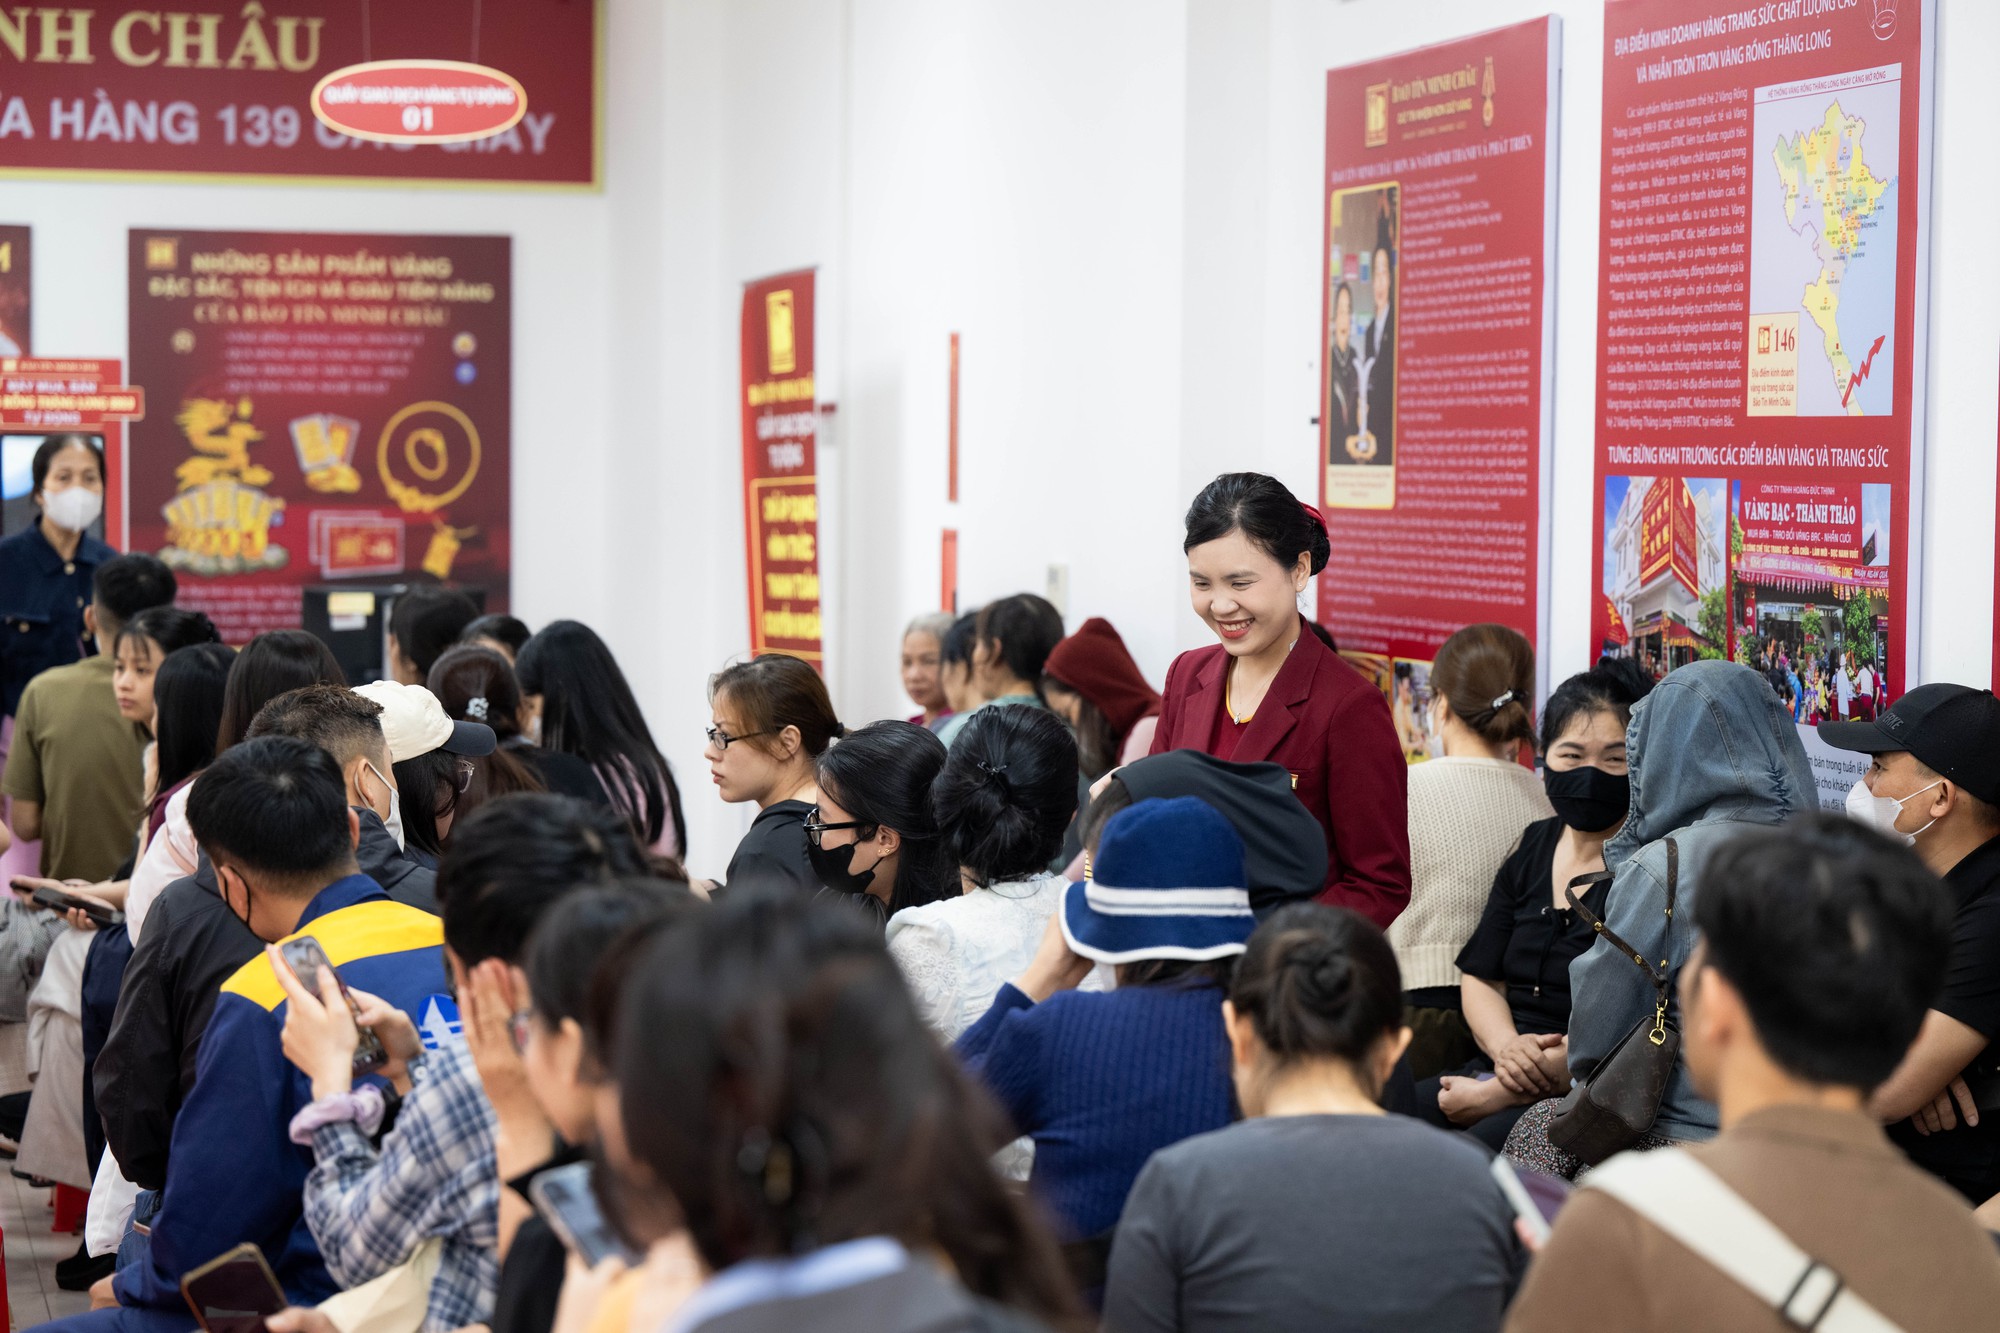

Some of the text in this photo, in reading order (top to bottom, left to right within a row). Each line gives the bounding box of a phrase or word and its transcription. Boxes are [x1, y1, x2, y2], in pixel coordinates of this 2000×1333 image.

[110, 1, 325, 72] CHÂU
[1615, 37, 1628, 59] ĐỊA
[1630, 28, 1649, 54] ĐIỂM
[1651, 29, 1670, 49] KINH
[1672, 21, 1701, 45] DOANH
[1703, 15, 1726, 39] VÀNG
[1728, 9, 1756, 32] TRANG
[1758, 1, 1776, 26] SỨC
[1637, 29, 1831, 83] VÀ NHẪN TRÒN TRƠN VÀNG RỒNG THĂNG LONG
[1768, 70, 1886, 99] HỆ THỐNG VÀNG RỒNG THĂNG LONG NGÀY CÀNG MỞ RỘNG
[50, 87, 200, 144] HÀNG
[215, 105, 300, 147] 139
[401, 106, 433, 131] 01
[1775, 327, 1795, 352] 146
[1760, 366, 1770, 377] điểm
[1771, 368, 1780, 377] kinh
[1781, 367, 1794, 377] doanh
[1769, 398, 1779, 406] Minh
[1780, 397, 1790, 407] Châu
[1633, 443, 1657, 464] BỪNG
[1659, 446, 1679, 464] KHAI
[1681, 445, 1718, 465] TRƯƠNG
[1720, 444, 1738, 465] CÁC
[1740, 441, 1763, 466] ĐIỂM
[1766, 444, 1785, 466] BÁN
[1787, 444, 1814, 467] VÀNG
[1816, 444, 1829, 467] VÀ
[1831, 448, 1865, 467] TRANG
[1868, 445, 1888, 468] SỨC
[1761, 484, 1835, 497] CÔNG TY TNHH HOÀNG ĐỨC THỊNH
[1744, 496, 1855, 526] VÀNG BẠC THÀNH THẢO
[1747, 529, 1851, 543] MUA BÁN TRAO ĐỔI VÀNG BẠC NHẪN CƯỚI
[1883, 712, 1904, 730] ERKE
[1814, 755, 1862, 775] bán trong tuần lễ
[1821, 777, 1849, 792] cho khách
